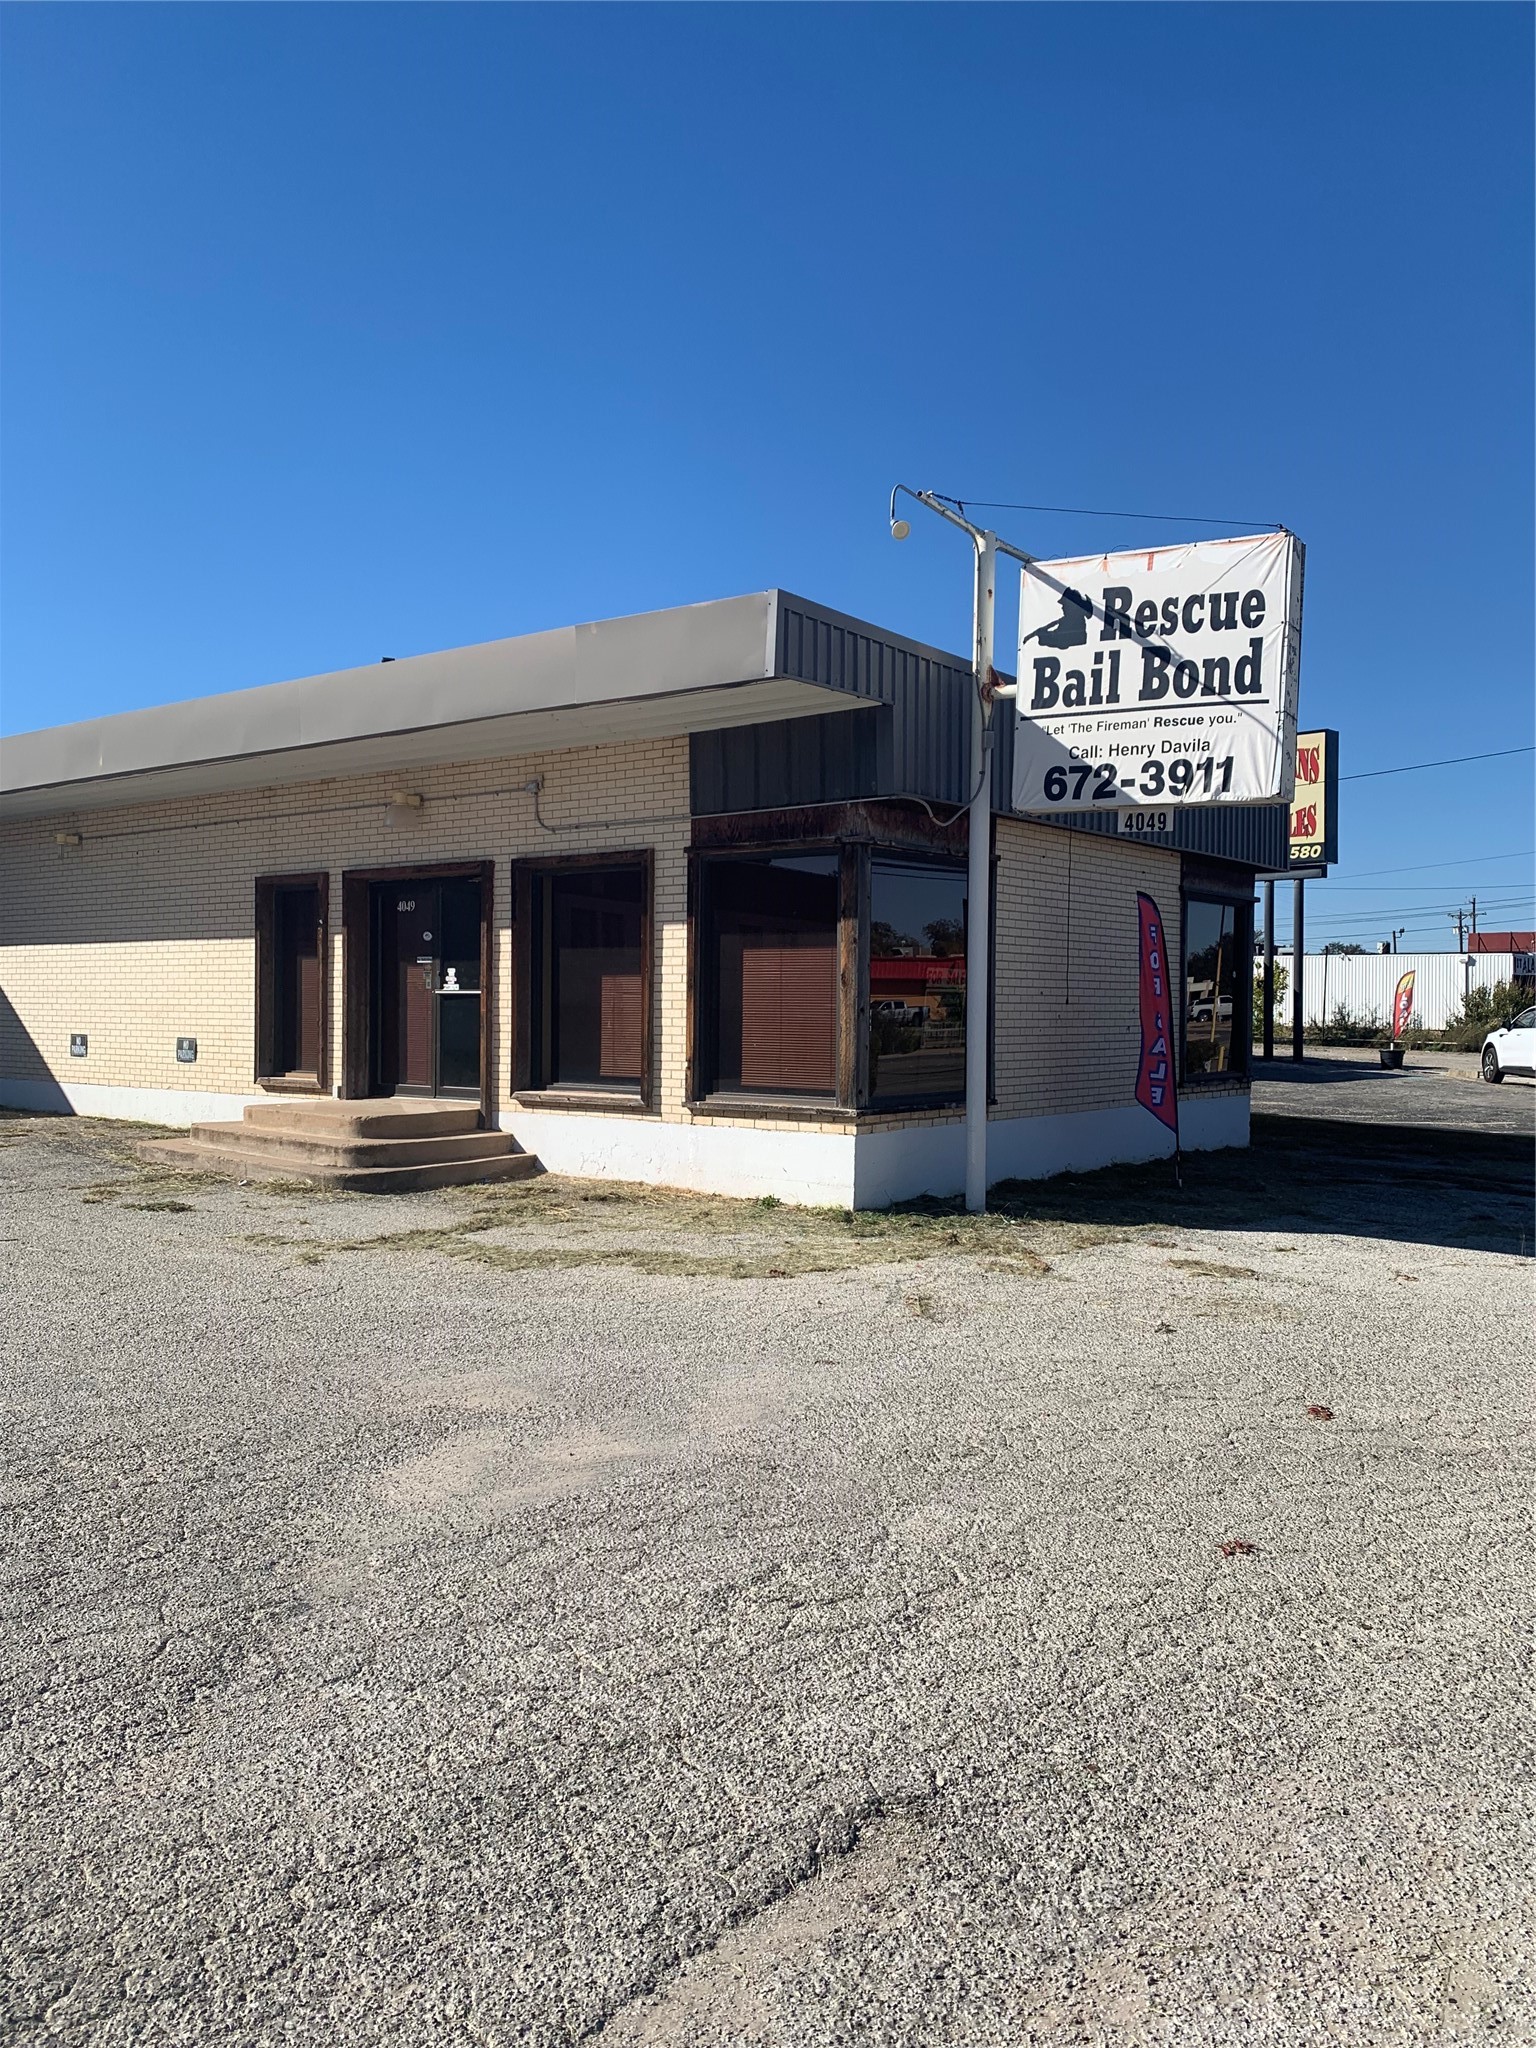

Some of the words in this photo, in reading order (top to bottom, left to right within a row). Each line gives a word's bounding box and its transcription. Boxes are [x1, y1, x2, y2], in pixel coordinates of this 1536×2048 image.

[1100, 586, 1266, 642] Rescue
[1031, 650, 1121, 710] Bail
[1138, 637, 1264, 701] Bond
[1096, 718, 1150, 732] Fireman'
[1153, 715, 1204, 728] Rescue
[1208, 712, 1243, 728] you."
[1069, 745, 1103, 760] Call:
[1108, 742, 1156, 758] Henry
[1161, 738, 1211, 754] Davila
[1043, 756, 1235, 802] 672-3911
[1124, 812, 1167, 832] 4049
[397, 900, 416, 912] 4049
